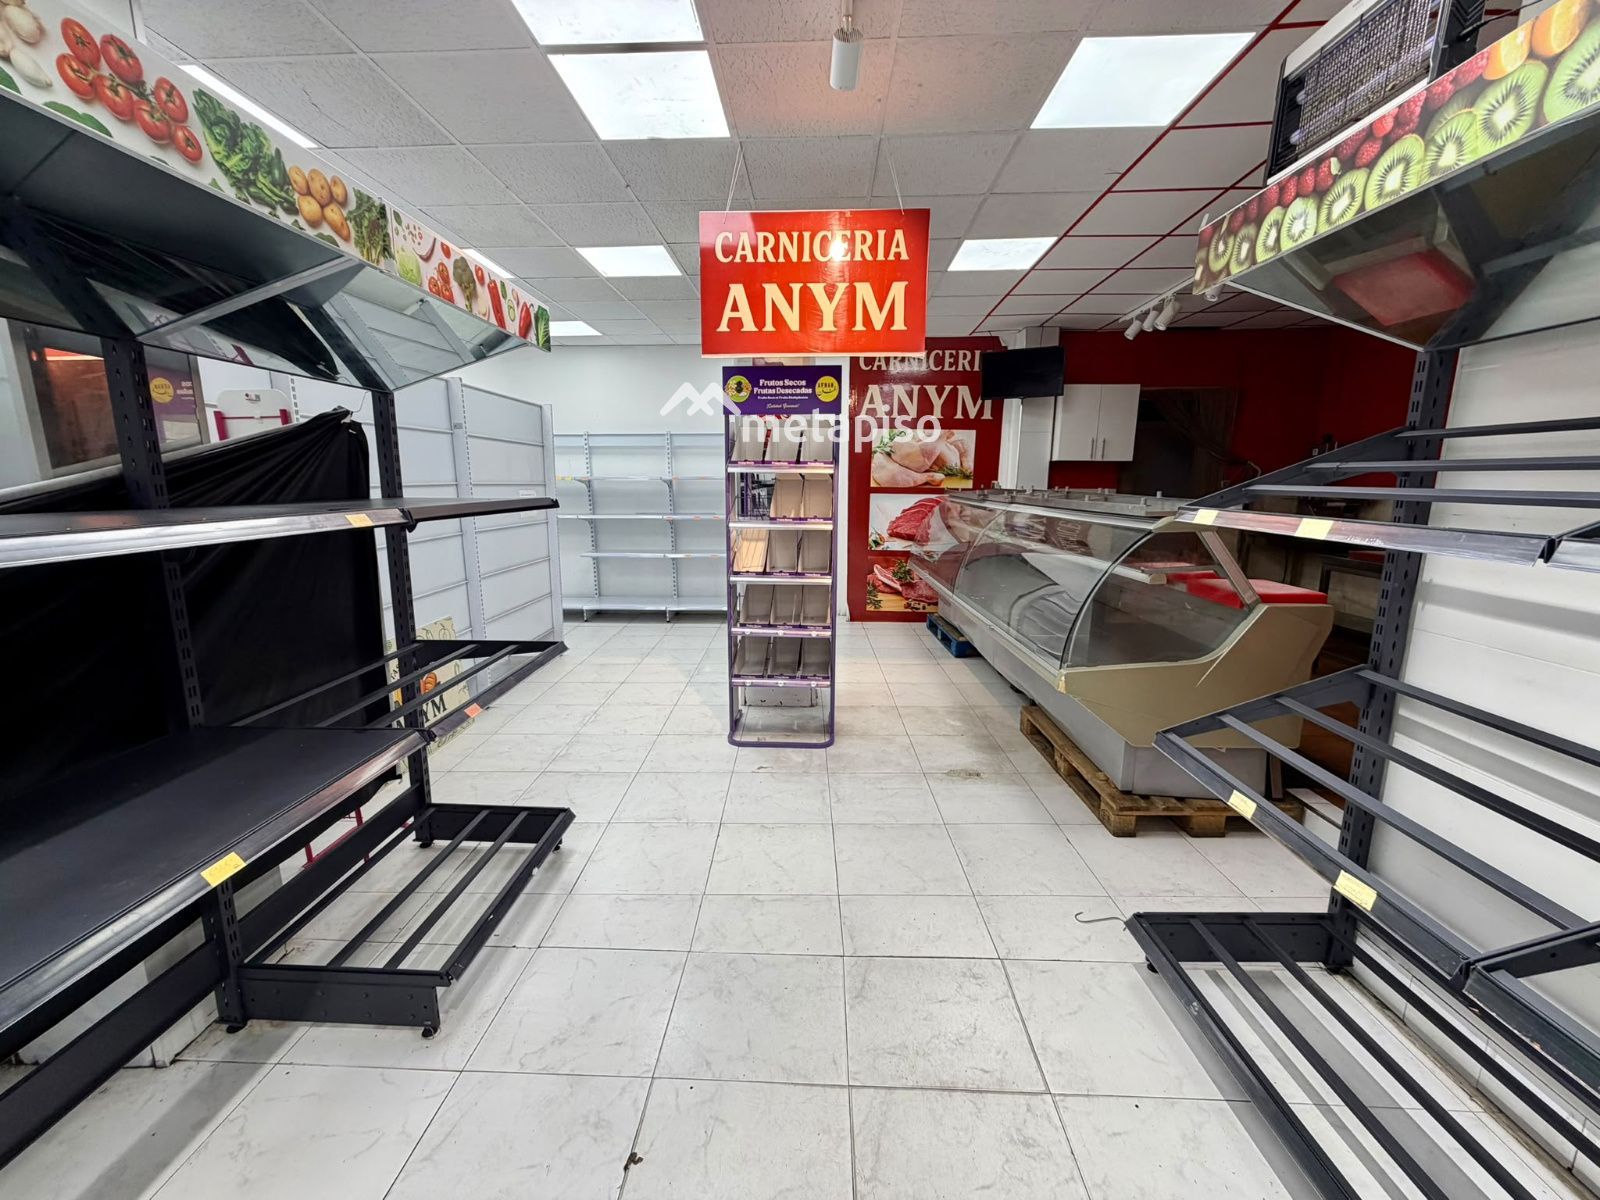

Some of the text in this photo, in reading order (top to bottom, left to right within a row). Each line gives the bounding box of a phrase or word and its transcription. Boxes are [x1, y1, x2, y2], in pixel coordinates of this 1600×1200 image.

[715, 229, 910, 263] CARNICERIA
[716, 281, 909, 332] ANYM
[859, 349, 983, 371] CARNICERI
[860, 384, 994, 420] ANYM
